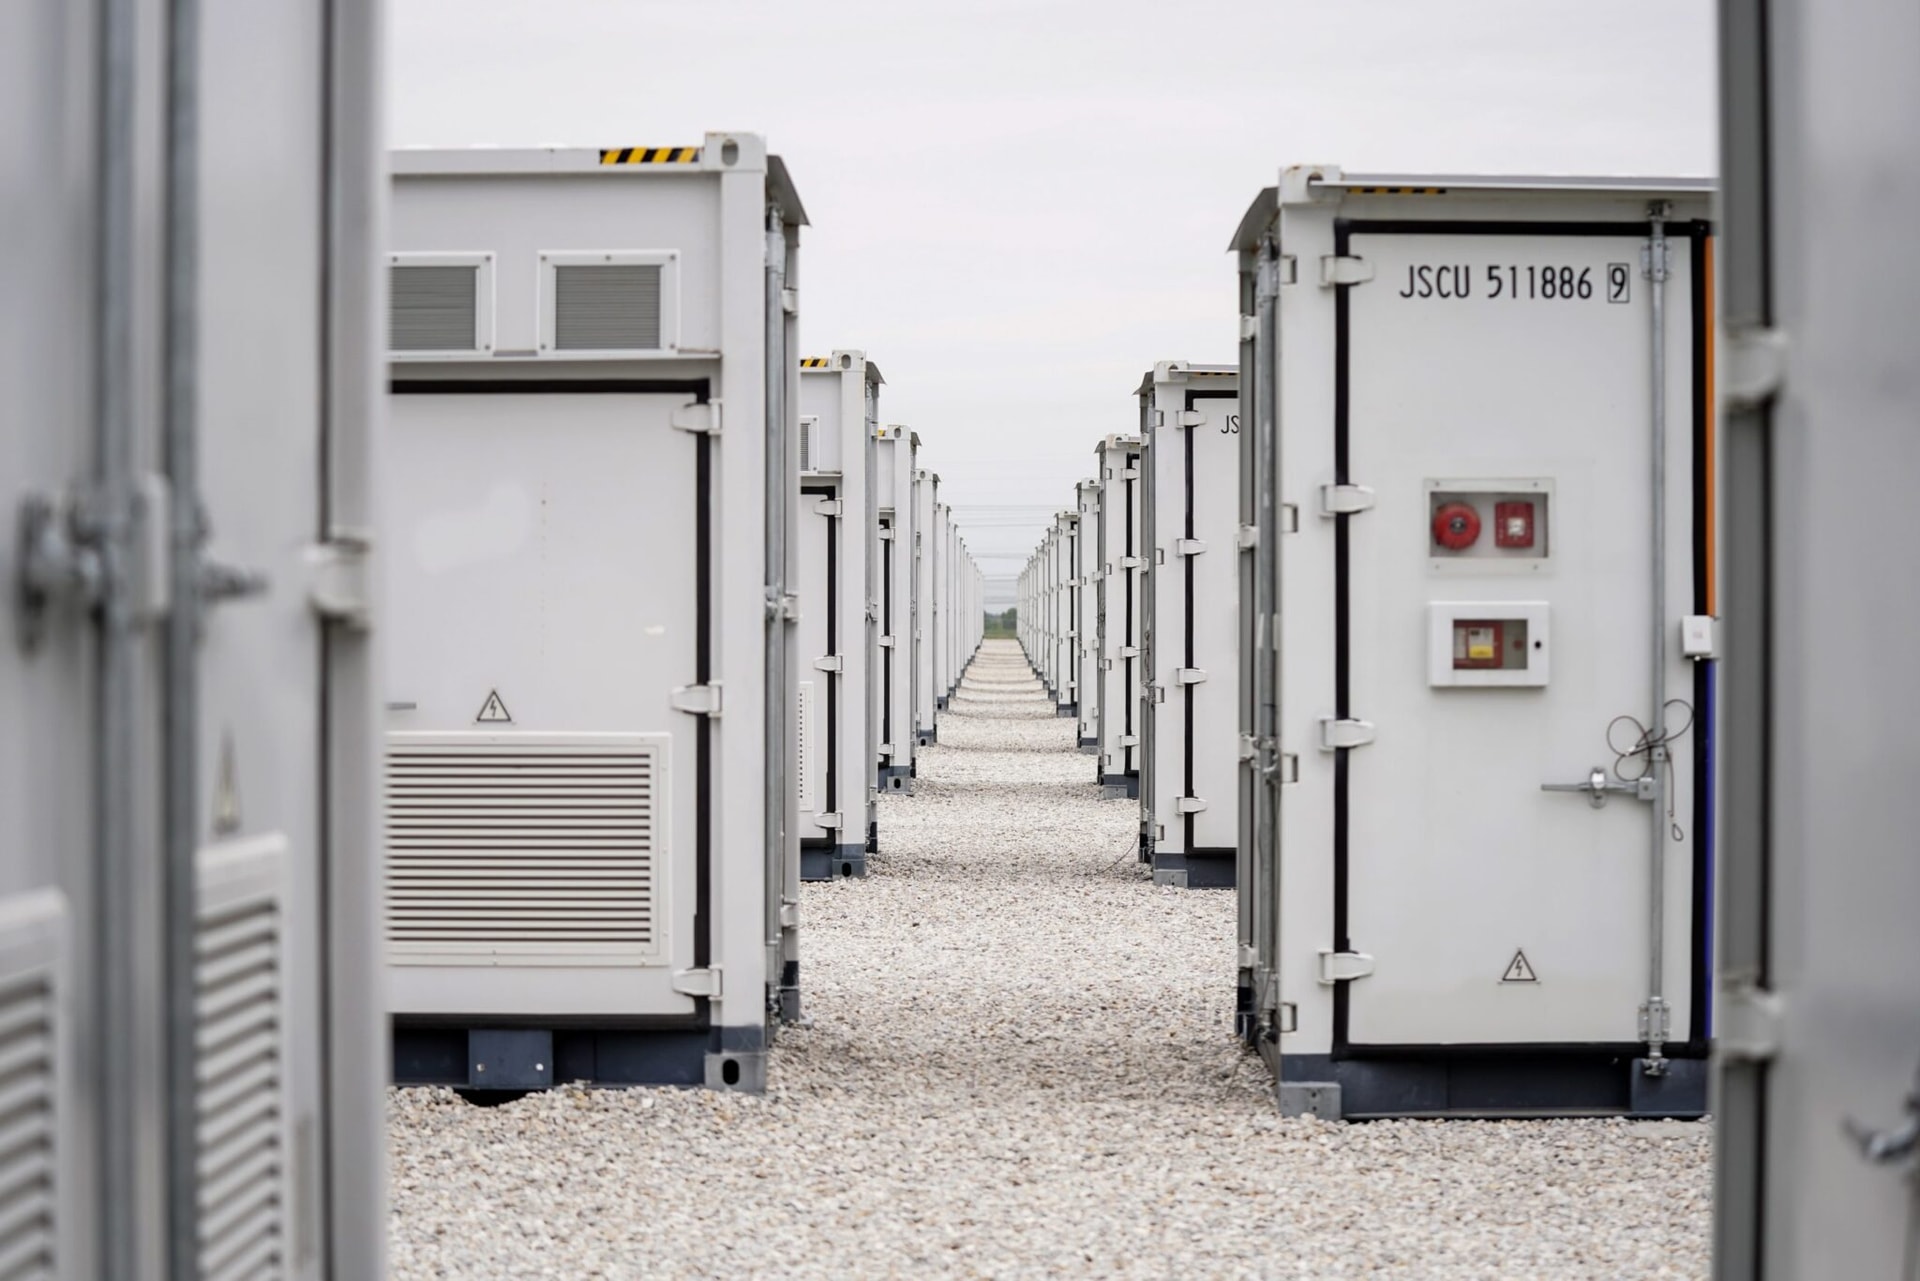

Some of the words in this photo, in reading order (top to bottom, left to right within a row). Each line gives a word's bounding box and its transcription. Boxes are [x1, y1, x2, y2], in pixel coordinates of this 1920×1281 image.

[1399, 264, 1470, 299] JSCU
[1486, 264, 1593, 300] 511886
[1610, 265, 1628, 301] 9
